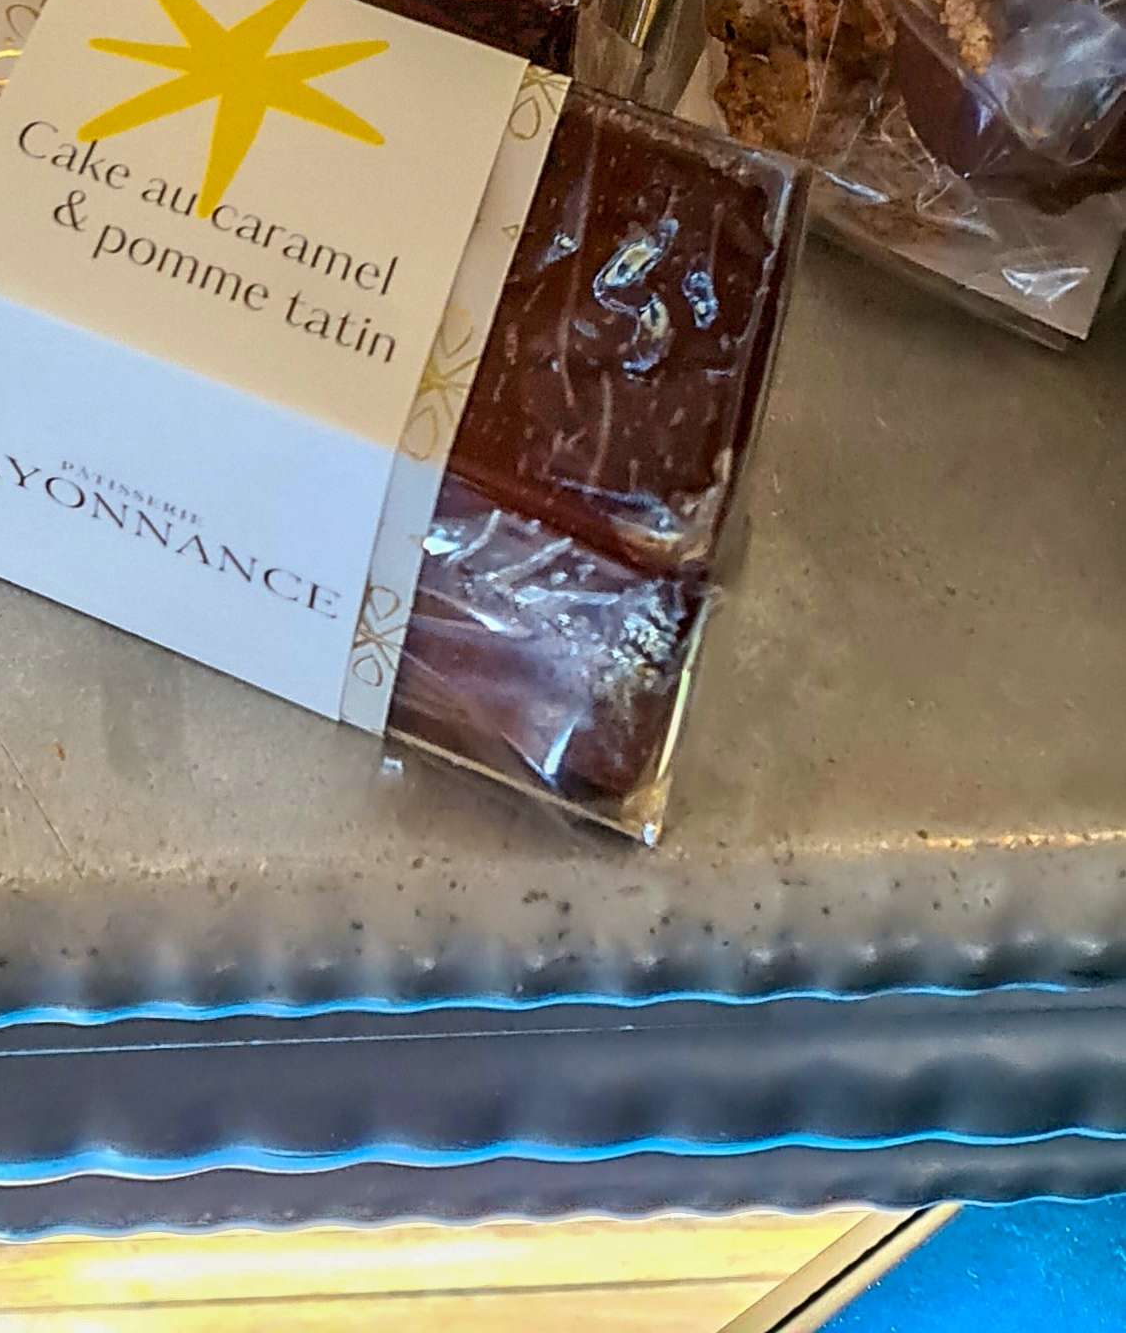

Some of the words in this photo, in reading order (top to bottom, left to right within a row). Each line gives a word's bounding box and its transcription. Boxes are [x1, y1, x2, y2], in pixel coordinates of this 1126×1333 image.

[19, 120, 131, 190] Cake
[142, 177, 197, 217] au
[212, 203, 398, 295] caramel
[52, 190, 87, 231] &
[93, 225, 270, 312] pomme
[285, 291, 398, 364] tatin
